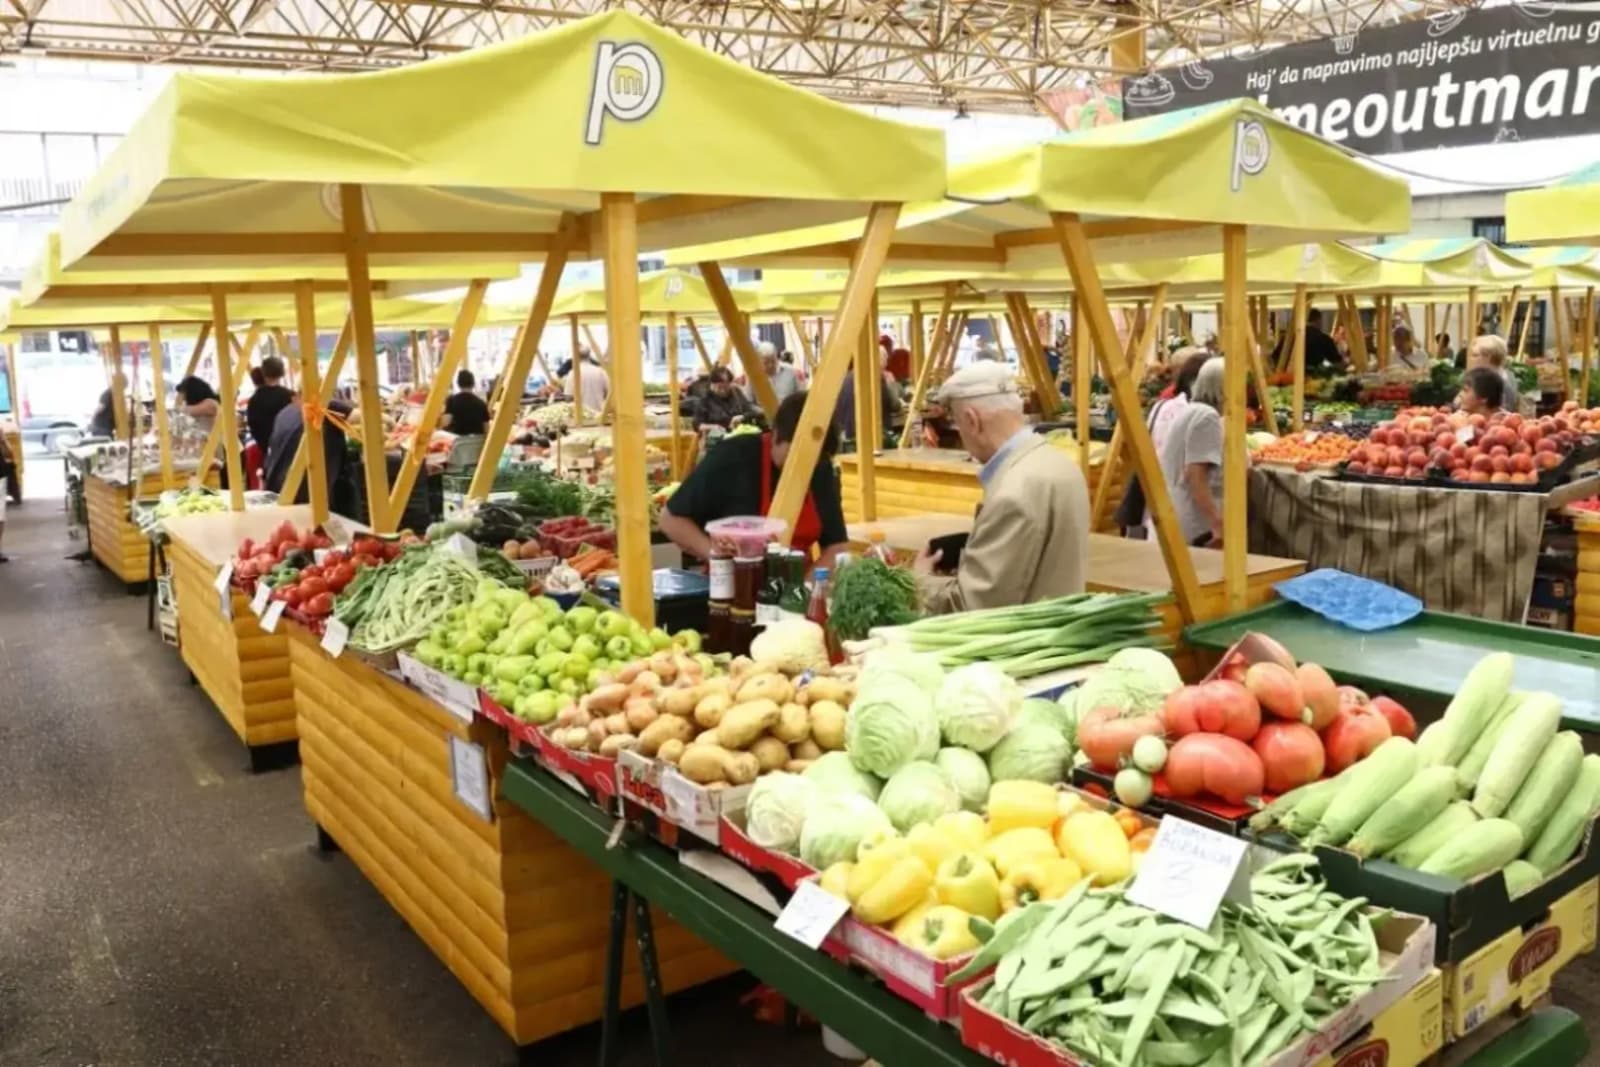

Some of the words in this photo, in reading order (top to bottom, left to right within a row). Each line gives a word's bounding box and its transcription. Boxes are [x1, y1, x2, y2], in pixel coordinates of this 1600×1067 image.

[1279, 65, 1299, 85] da
[1302, 52, 1392, 83] napravimo
[1396, 35, 1482, 68] najljepšu
[1487, 22, 1581, 51] virtuelnu
[1258, 65, 1600, 142] meoutmar
